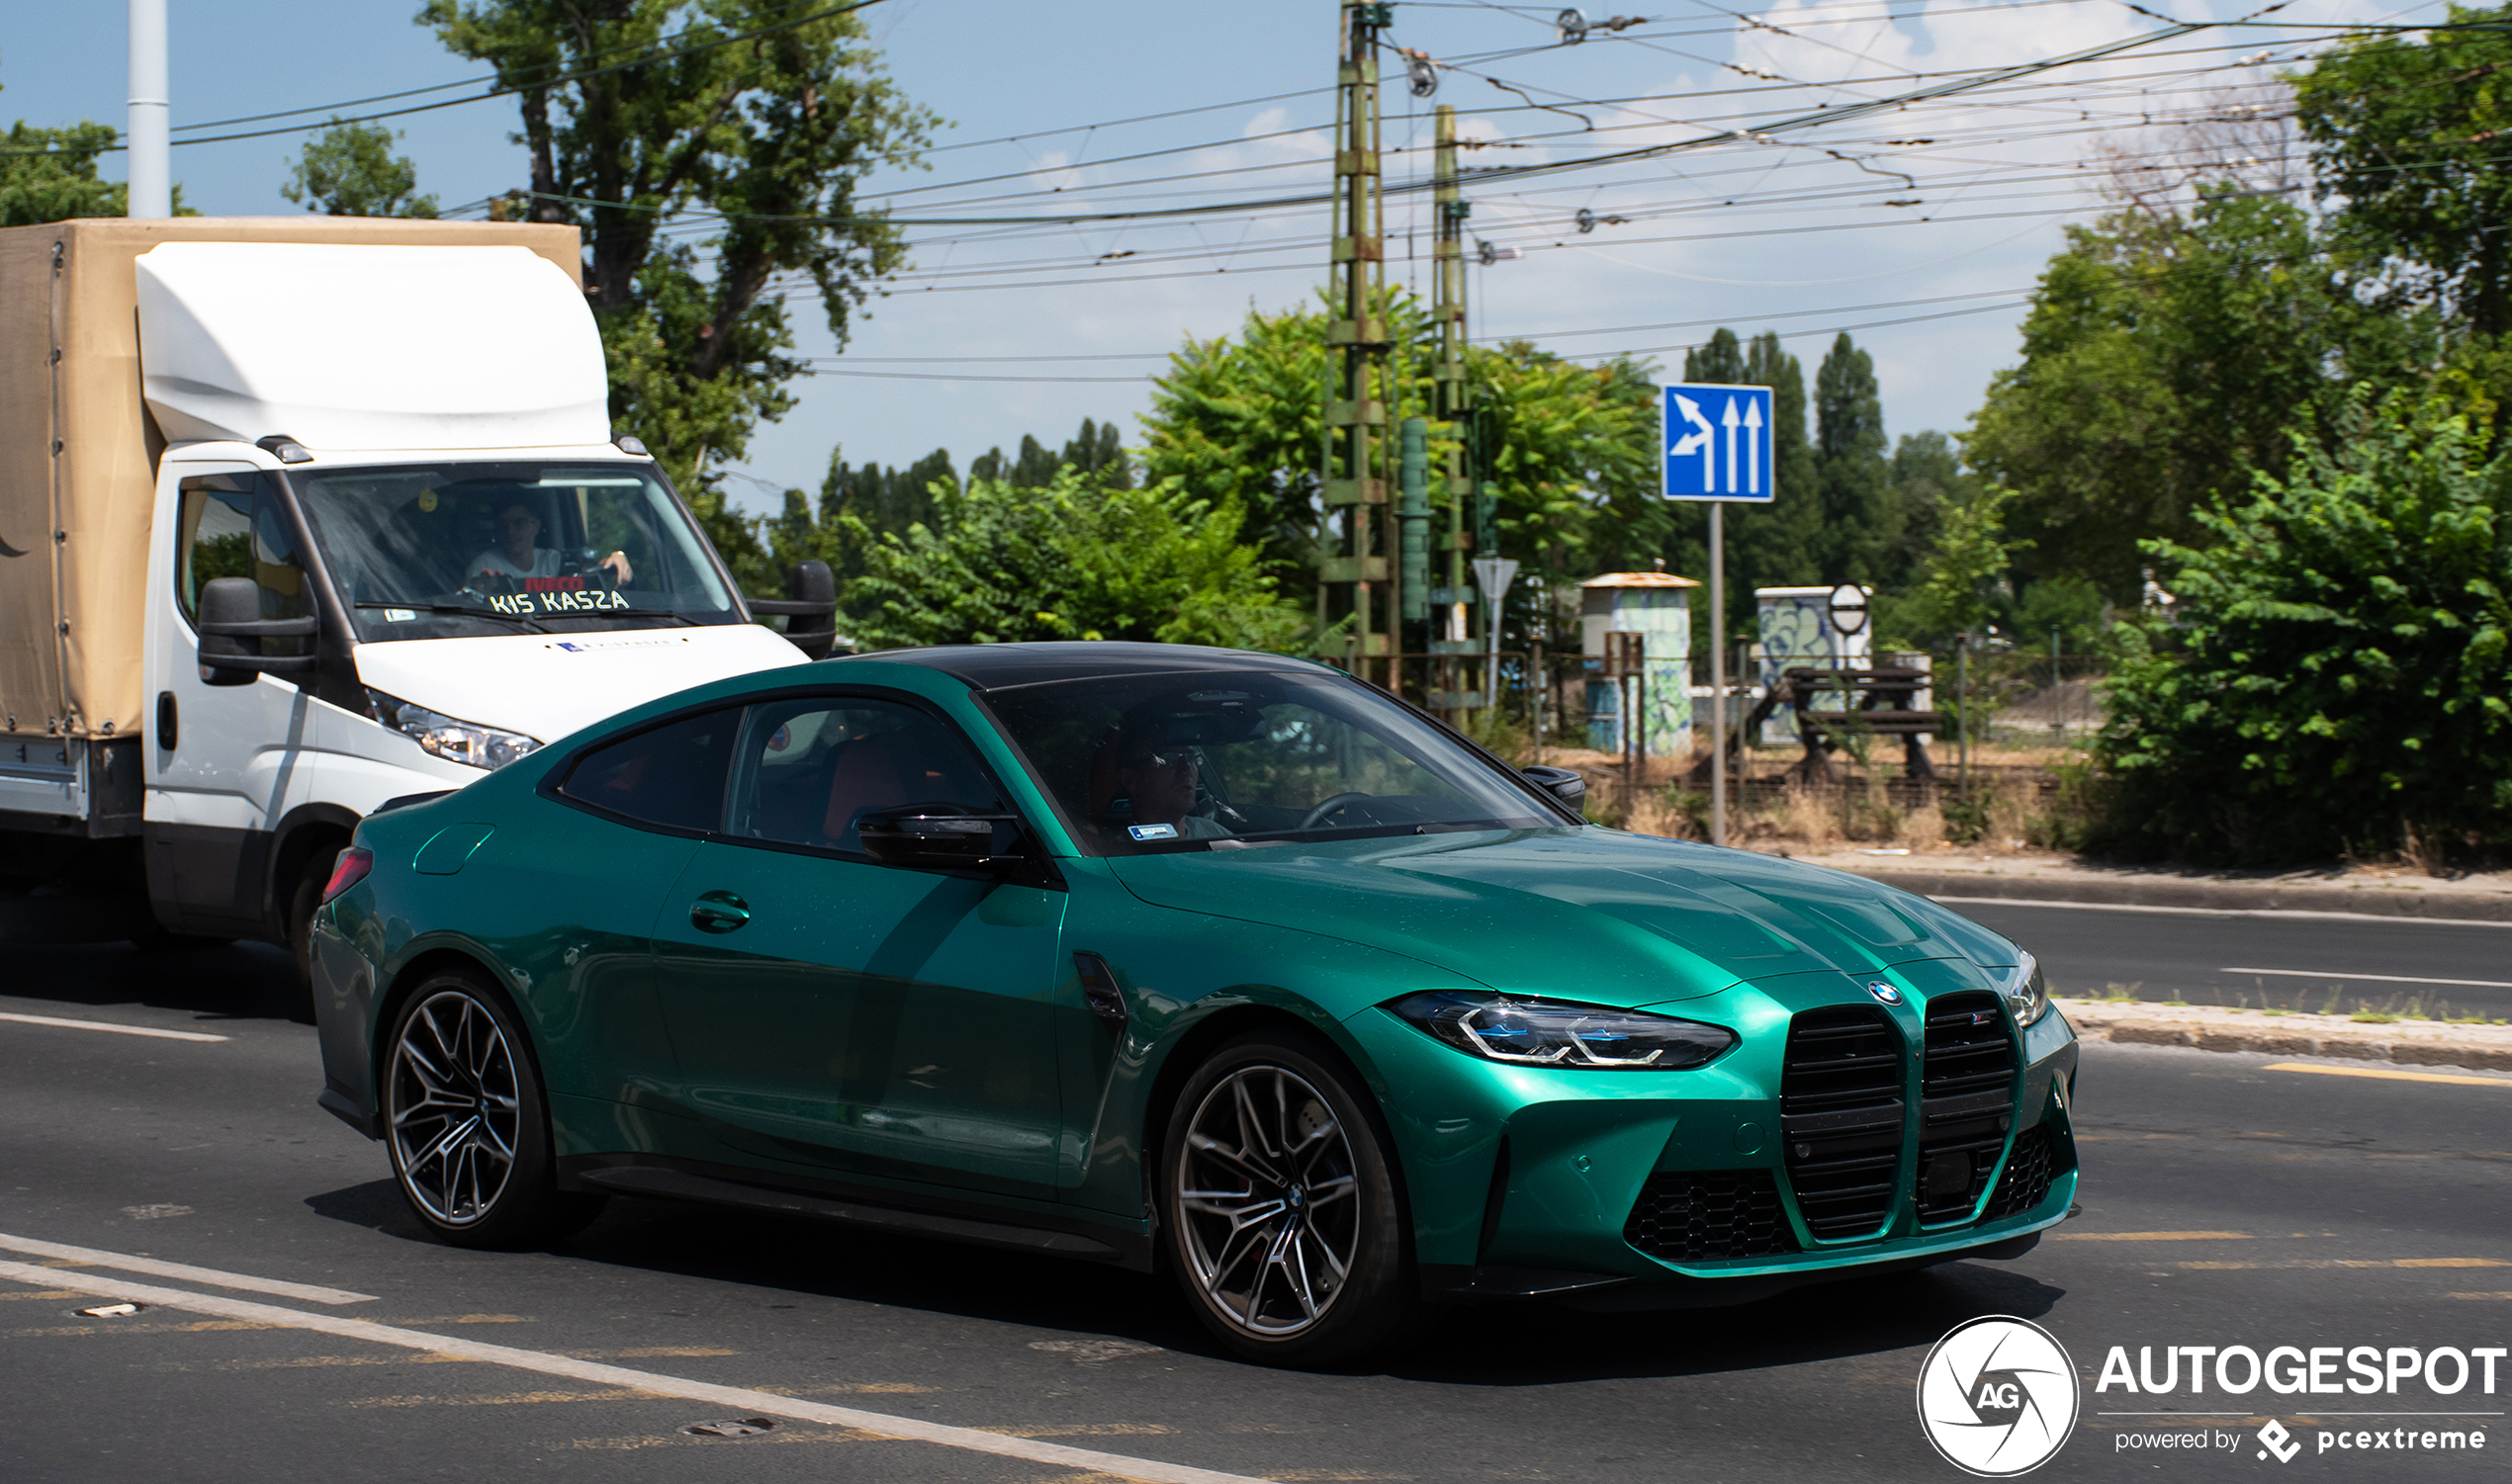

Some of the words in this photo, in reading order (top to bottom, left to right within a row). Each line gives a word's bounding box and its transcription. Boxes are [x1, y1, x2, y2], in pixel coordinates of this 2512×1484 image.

[525, 576, 583, 592] IVECO
[490, 593, 535, 614] KIS
[540, 590, 630, 611] KASZA
